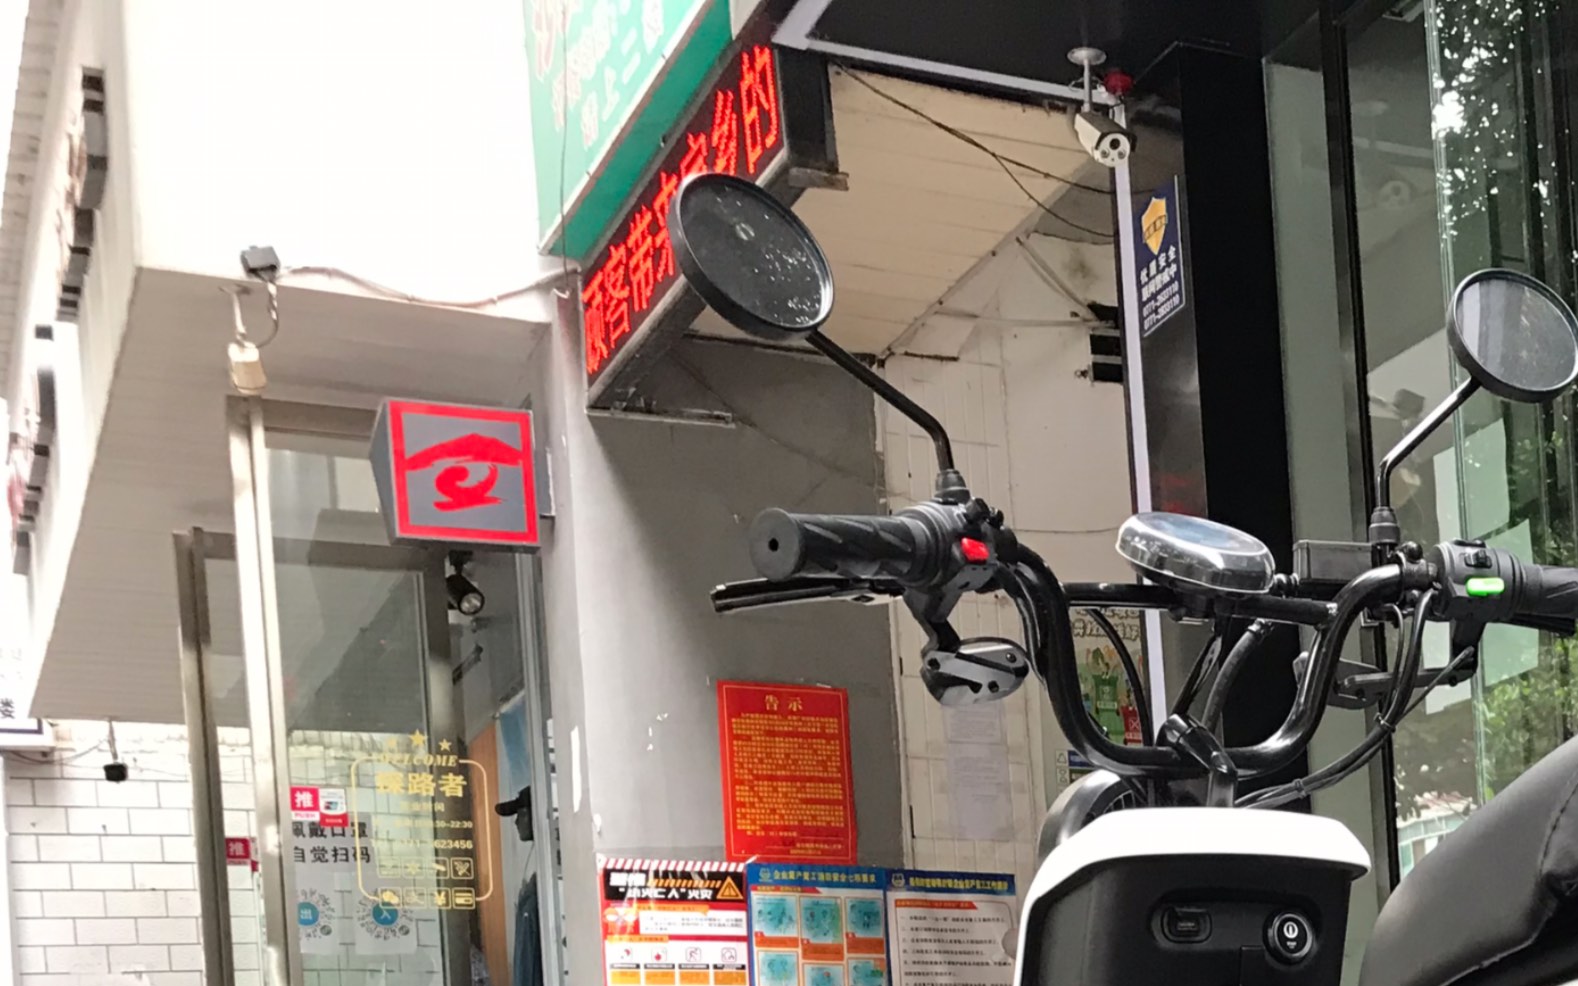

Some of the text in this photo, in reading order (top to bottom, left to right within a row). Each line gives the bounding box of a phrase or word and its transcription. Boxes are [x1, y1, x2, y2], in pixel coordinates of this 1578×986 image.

[765, 694, 803, 711] 告示
[295, 791, 314, 808] 推
[293, 846, 371, 864] 自觉扫码
